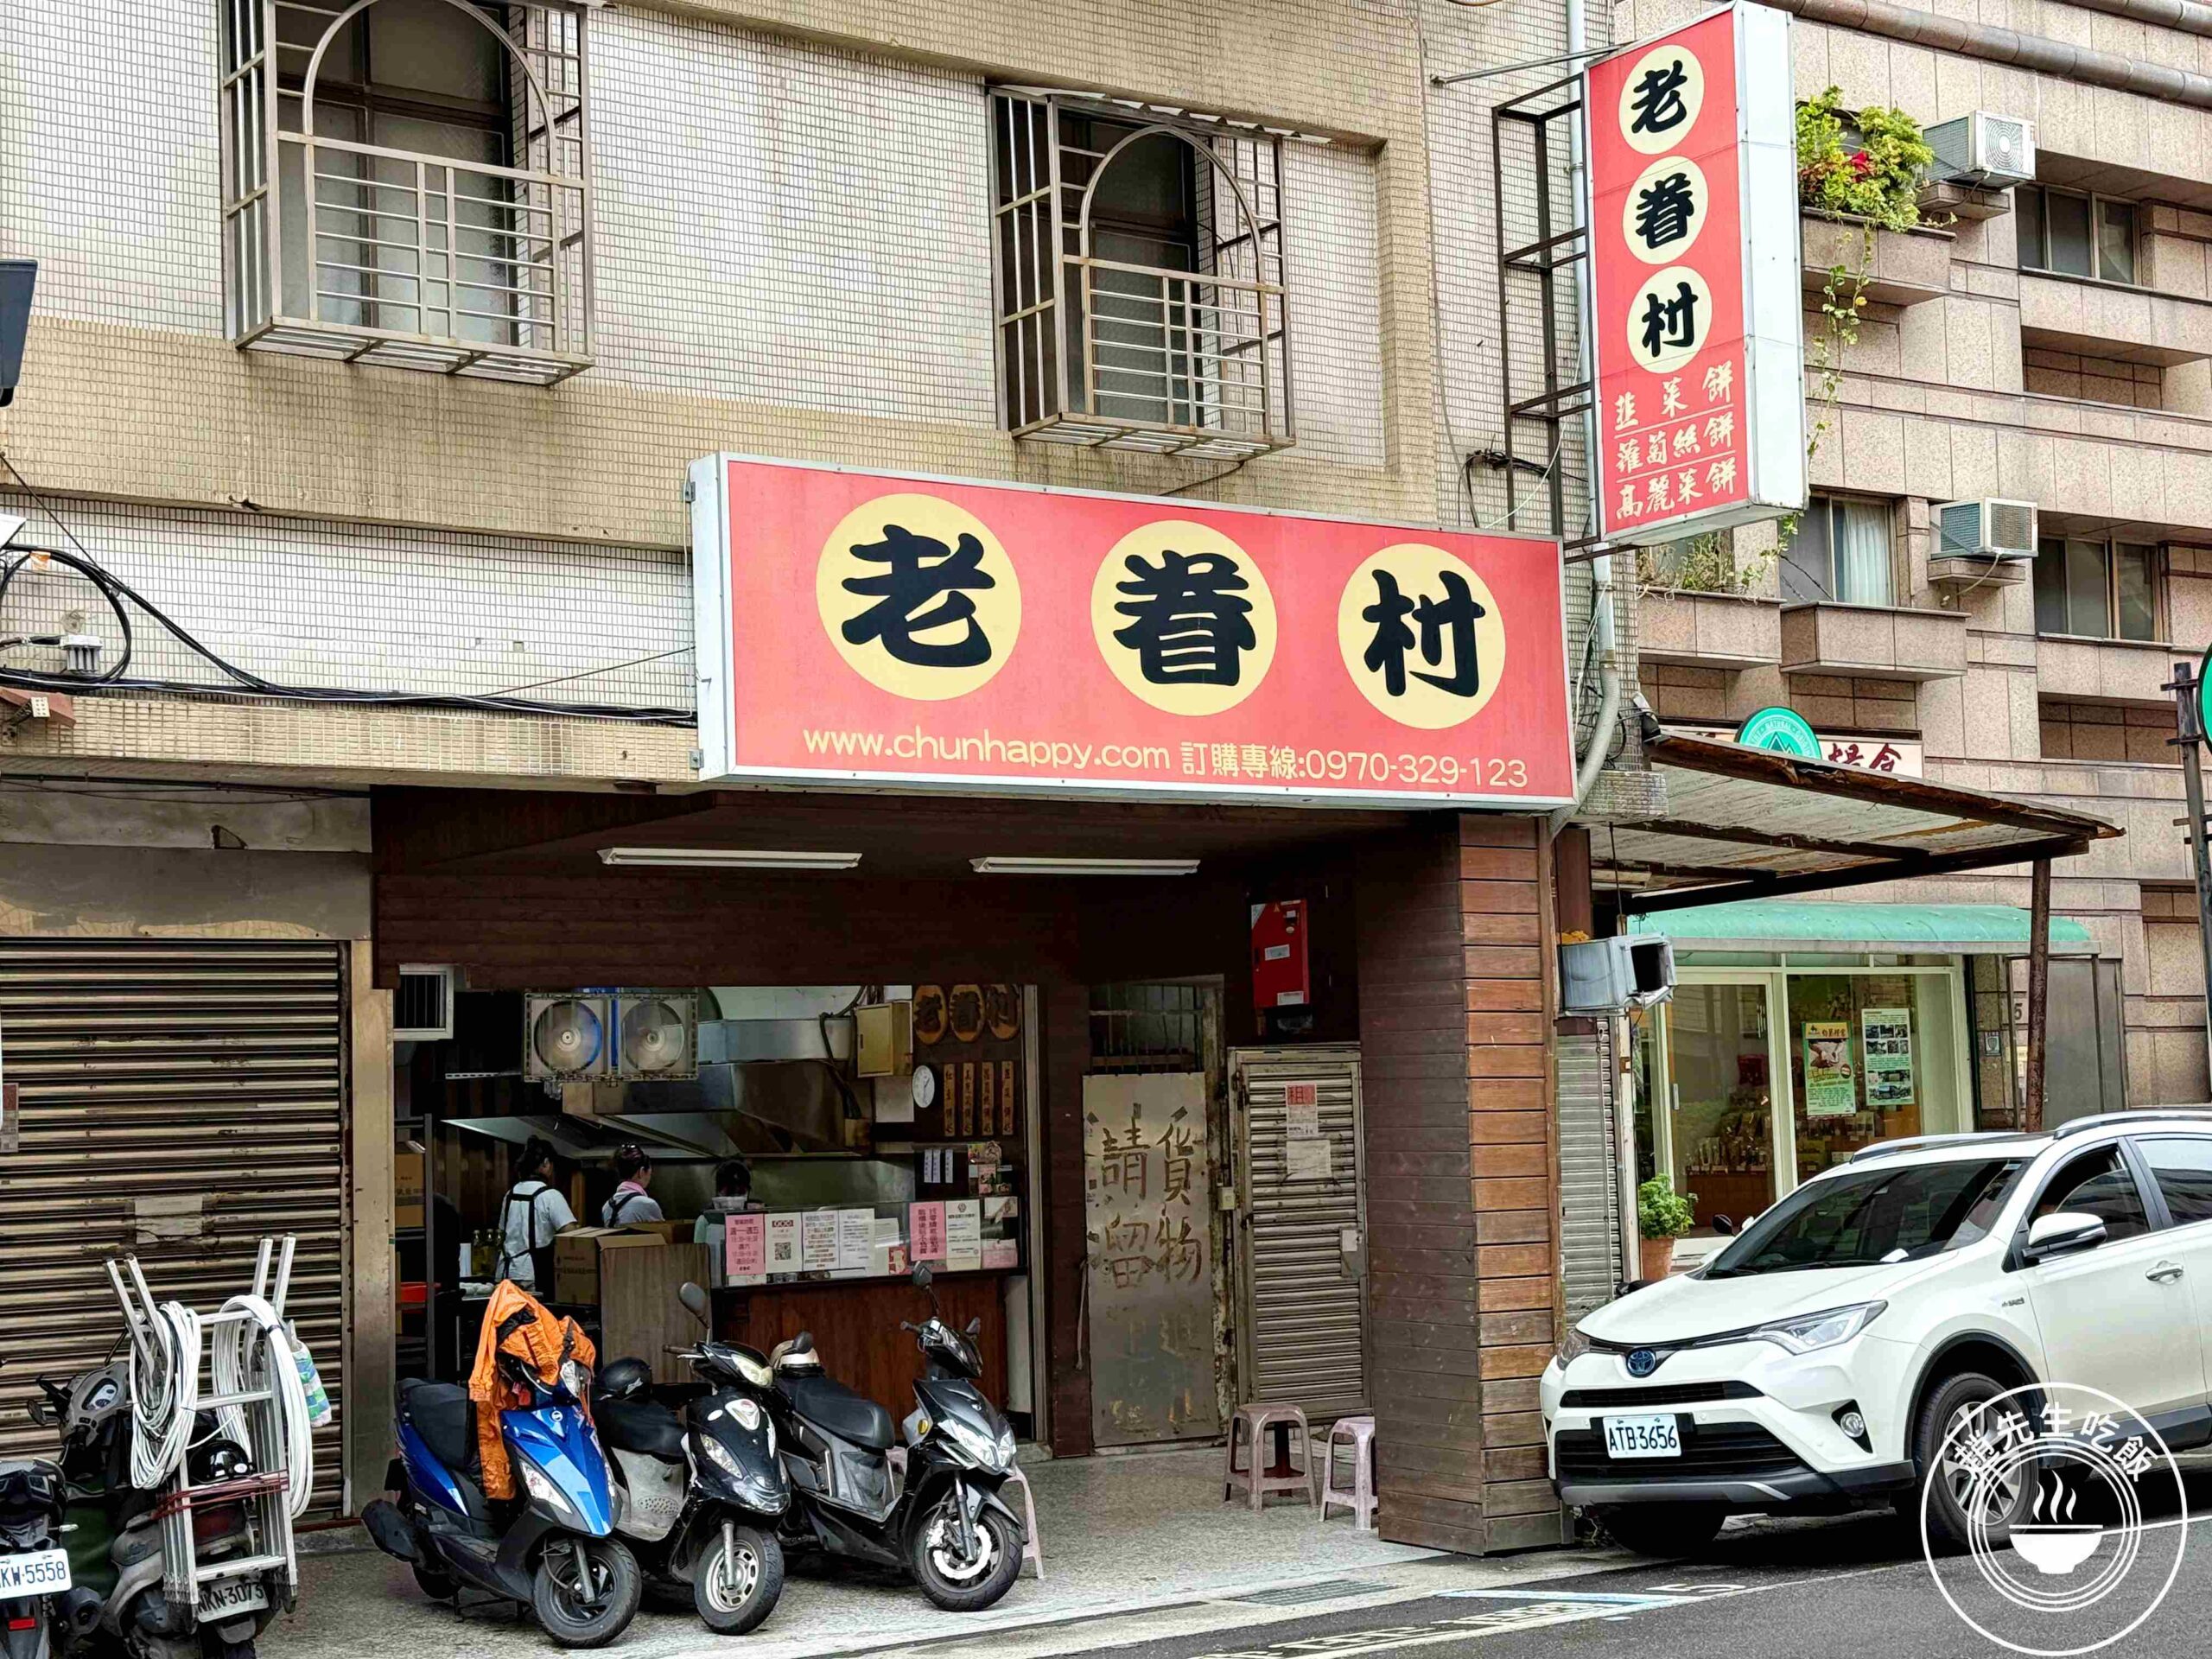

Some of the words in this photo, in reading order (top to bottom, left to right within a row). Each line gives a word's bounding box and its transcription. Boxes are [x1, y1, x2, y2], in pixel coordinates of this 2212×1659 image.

[1631, 60, 1699, 358] 老眷村
[1616, 411, 1735, 474] 蘿蔔絲餅
[1616, 457, 1737, 519] 高麗菜餅
[842, 524, 1486, 697] 老眷村
[803, 724, 1170, 770] www.chunhappy.com
[1608, 1425, 1677, 1452] ATB-3656
[0, 1561, 67, 1588] KW-5558
